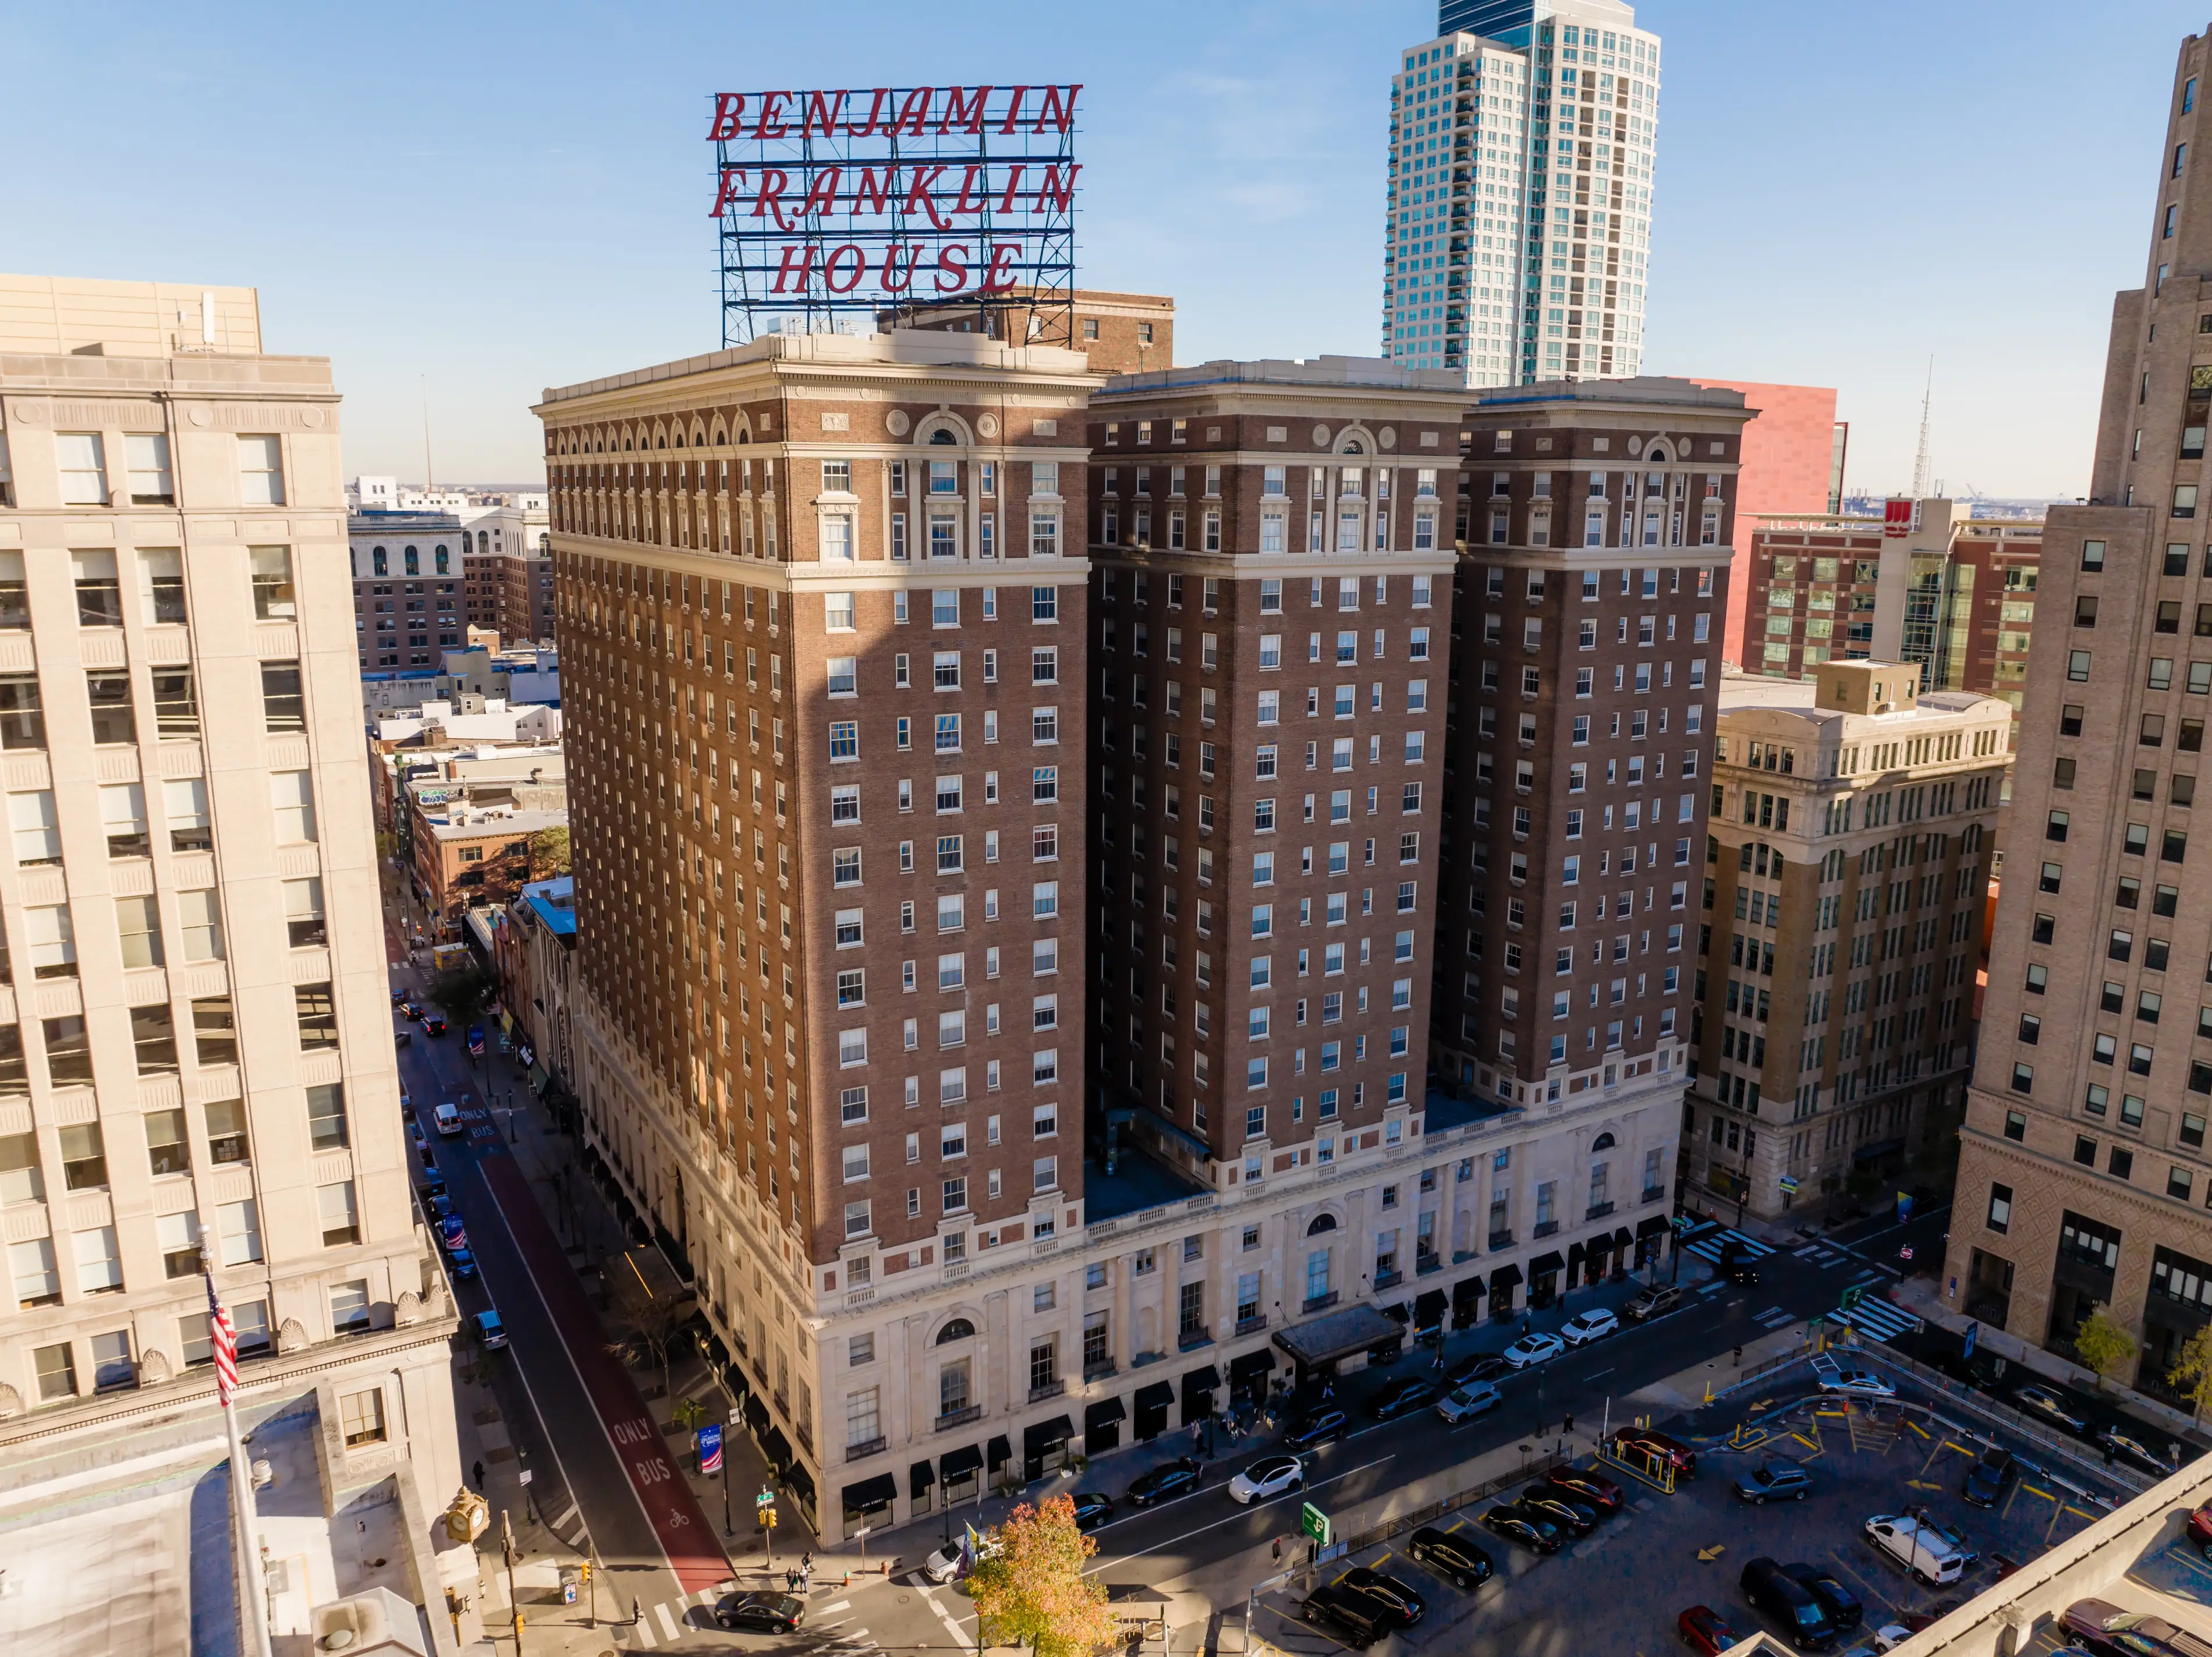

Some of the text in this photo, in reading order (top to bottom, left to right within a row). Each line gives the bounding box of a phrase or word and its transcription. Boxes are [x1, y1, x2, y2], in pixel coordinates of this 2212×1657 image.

[706, 84, 1083, 141] BENJAMIN
[708, 164, 1083, 232] FRANKLIN
[770, 243, 1022, 294] HOUSE
[460, 1108, 487, 1120] ONLY
[471, 1125, 495, 1138] BUS
[614, 1417, 652, 1444] ONLY
[636, 1457, 671, 1485] BUS
